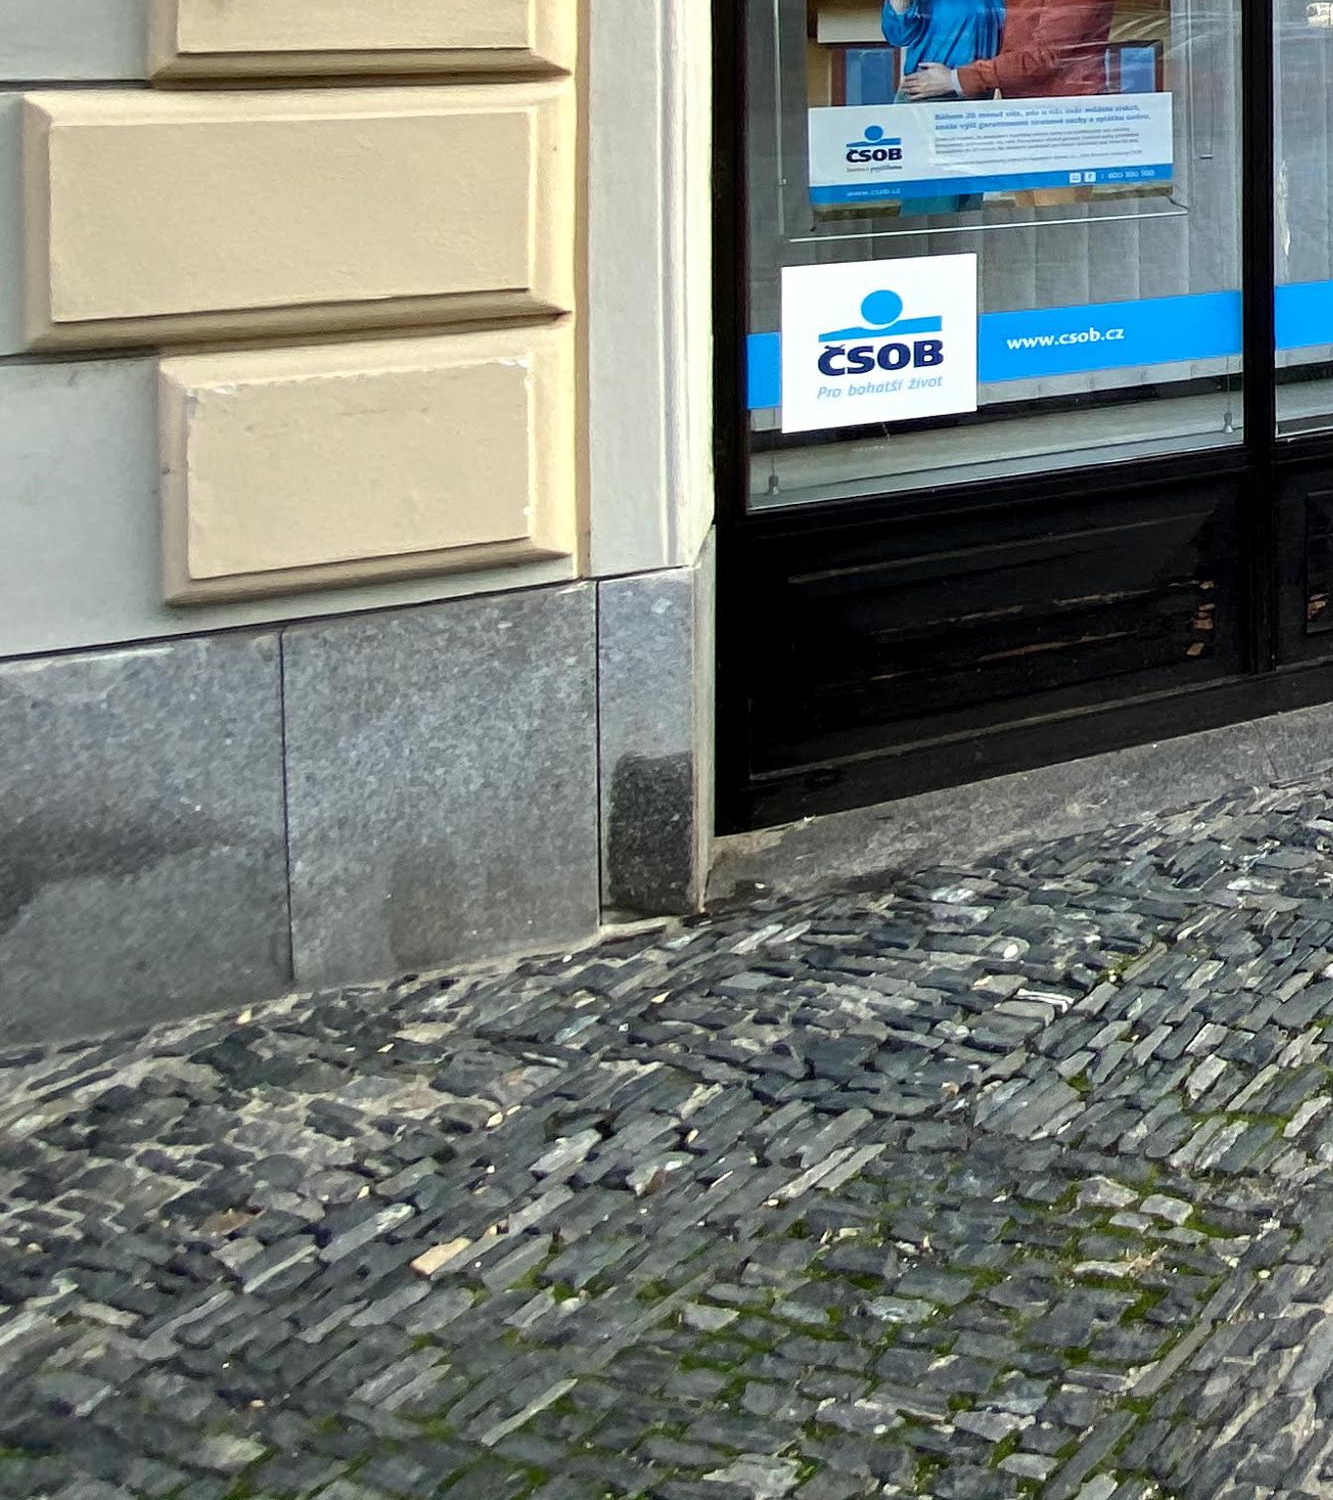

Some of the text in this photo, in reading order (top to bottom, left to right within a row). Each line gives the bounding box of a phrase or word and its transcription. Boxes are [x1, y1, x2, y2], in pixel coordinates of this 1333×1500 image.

[1006, 326, 1125, 350] www.csob.cz
[817, 339, 944, 376] ČSOB
[817, 375, 943, 400] Pro bohatší život
